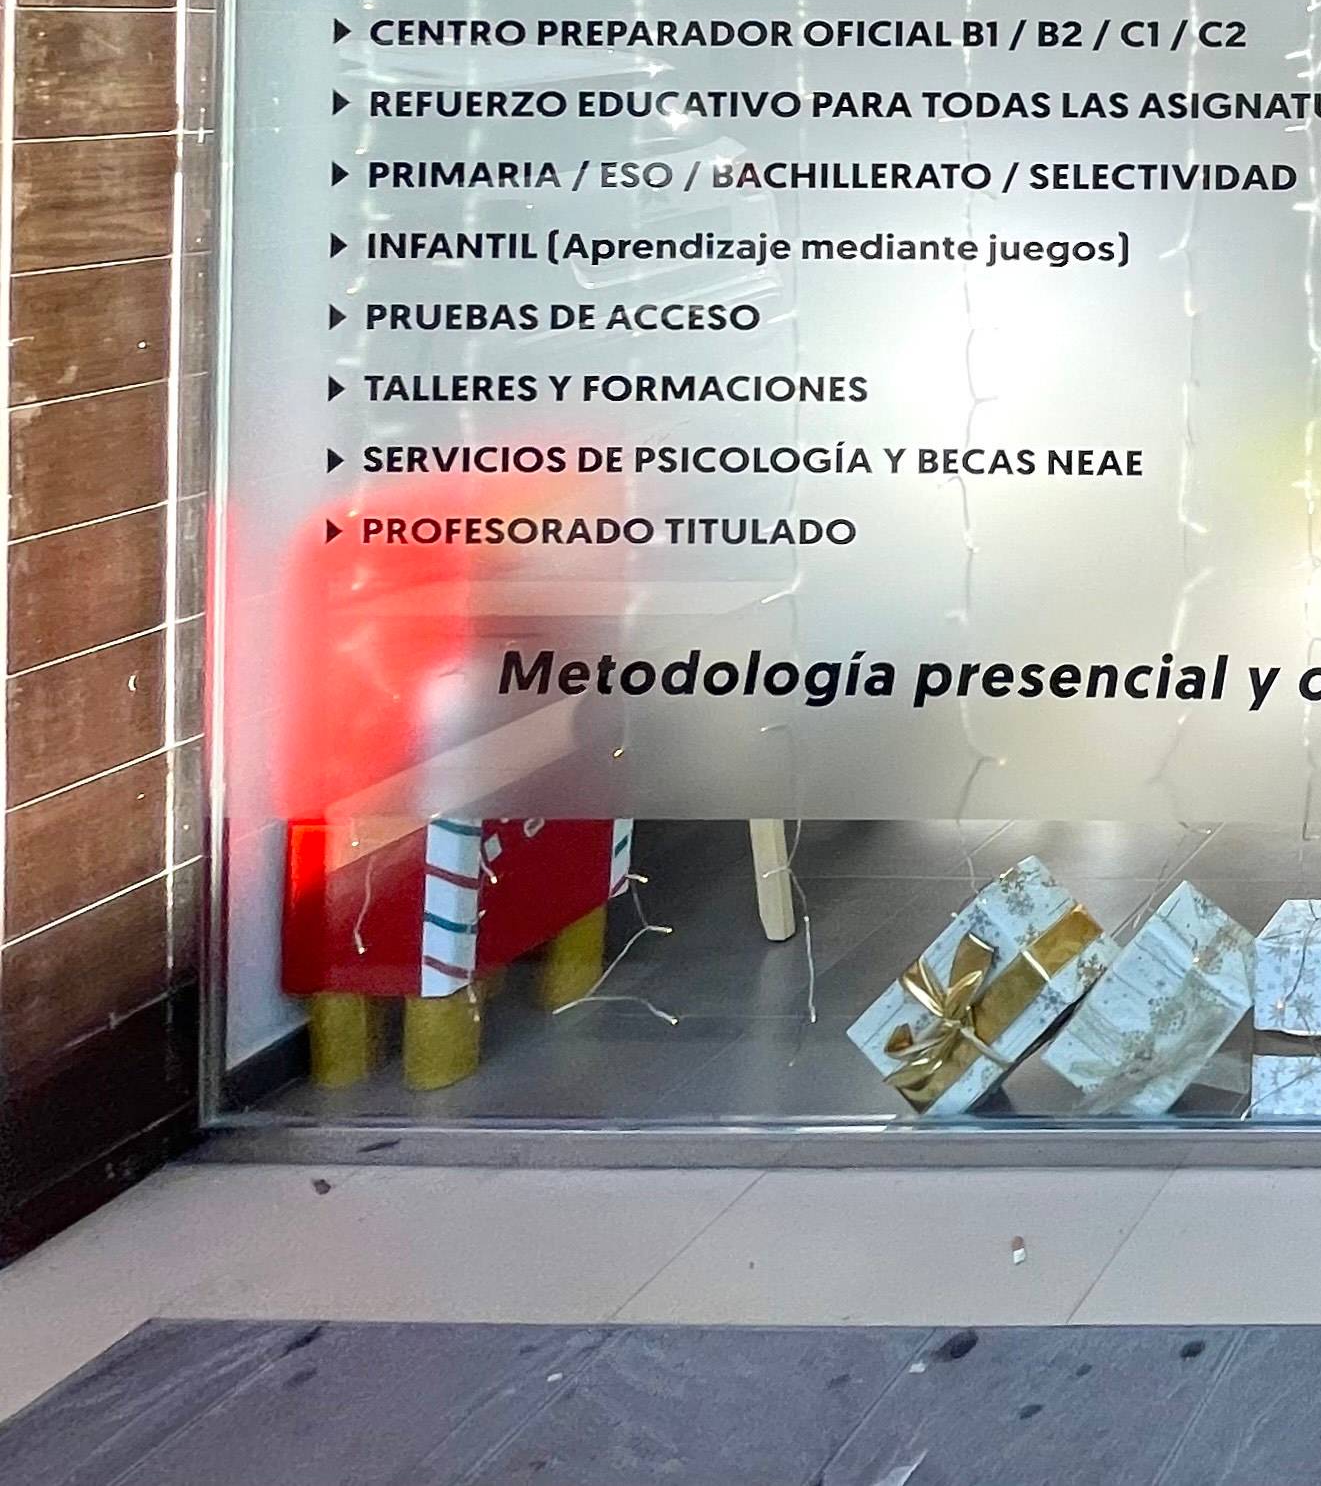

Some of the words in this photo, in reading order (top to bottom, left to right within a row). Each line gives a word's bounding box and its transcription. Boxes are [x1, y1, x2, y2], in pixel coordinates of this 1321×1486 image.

[370, 19, 526, 46] CENTRO
[537, 20, 793, 47] PREPARADOR
[803, 20, 952, 47] OFICIAL
[963, 21, 998, 47] B1
[1038, 21, 1083, 47] B2
[1120, 20, 1159, 48] C1
[1198, 21, 1246, 48] C2
[370, 90, 567, 118] REFUERZO
[578, 91, 801, 118] EDUCATIVO
[812, 91, 913, 118] PARA
[921, 92, 1051, 119] TODAS
[1062, 92, 1129, 119] LAS
[369, 161, 561, 188] PRIMARIA
[600, 161, 673, 189] ESO
[713, 162, 991, 190] BACHILLERATO
[1029, 163, 1297, 191] SELECTIVIDAD
[368, 232, 538, 259] INFANTIL
[801, 233, 979, 261] mediante
[366, 304, 538, 331] PRUEBAS
[550, 304, 595, 330] DE
[605, 304, 760, 331] ACCESO
[364, 375, 537, 402] TALLERES
[548, 375, 572, 402] Y
[583, 375, 868, 402] FORMACIONES
[363, 446, 566, 473] SERVICIOS
[578, 446, 623, 473] DE
[635, 441, 872, 474] PSICOLOGÍA
[883, 448, 907, 474] Y
[918, 448, 1036, 475] BECAS
[1048, 449, 1143, 476] NEAE
[363, 517, 654, 545] PROFESORADO
[664, 518, 856, 545] TITULADO
[498, 649, 895, 707] Metodología
[913, 653, 1229, 708] presencial
[1248, 667, 1281, 712] y
